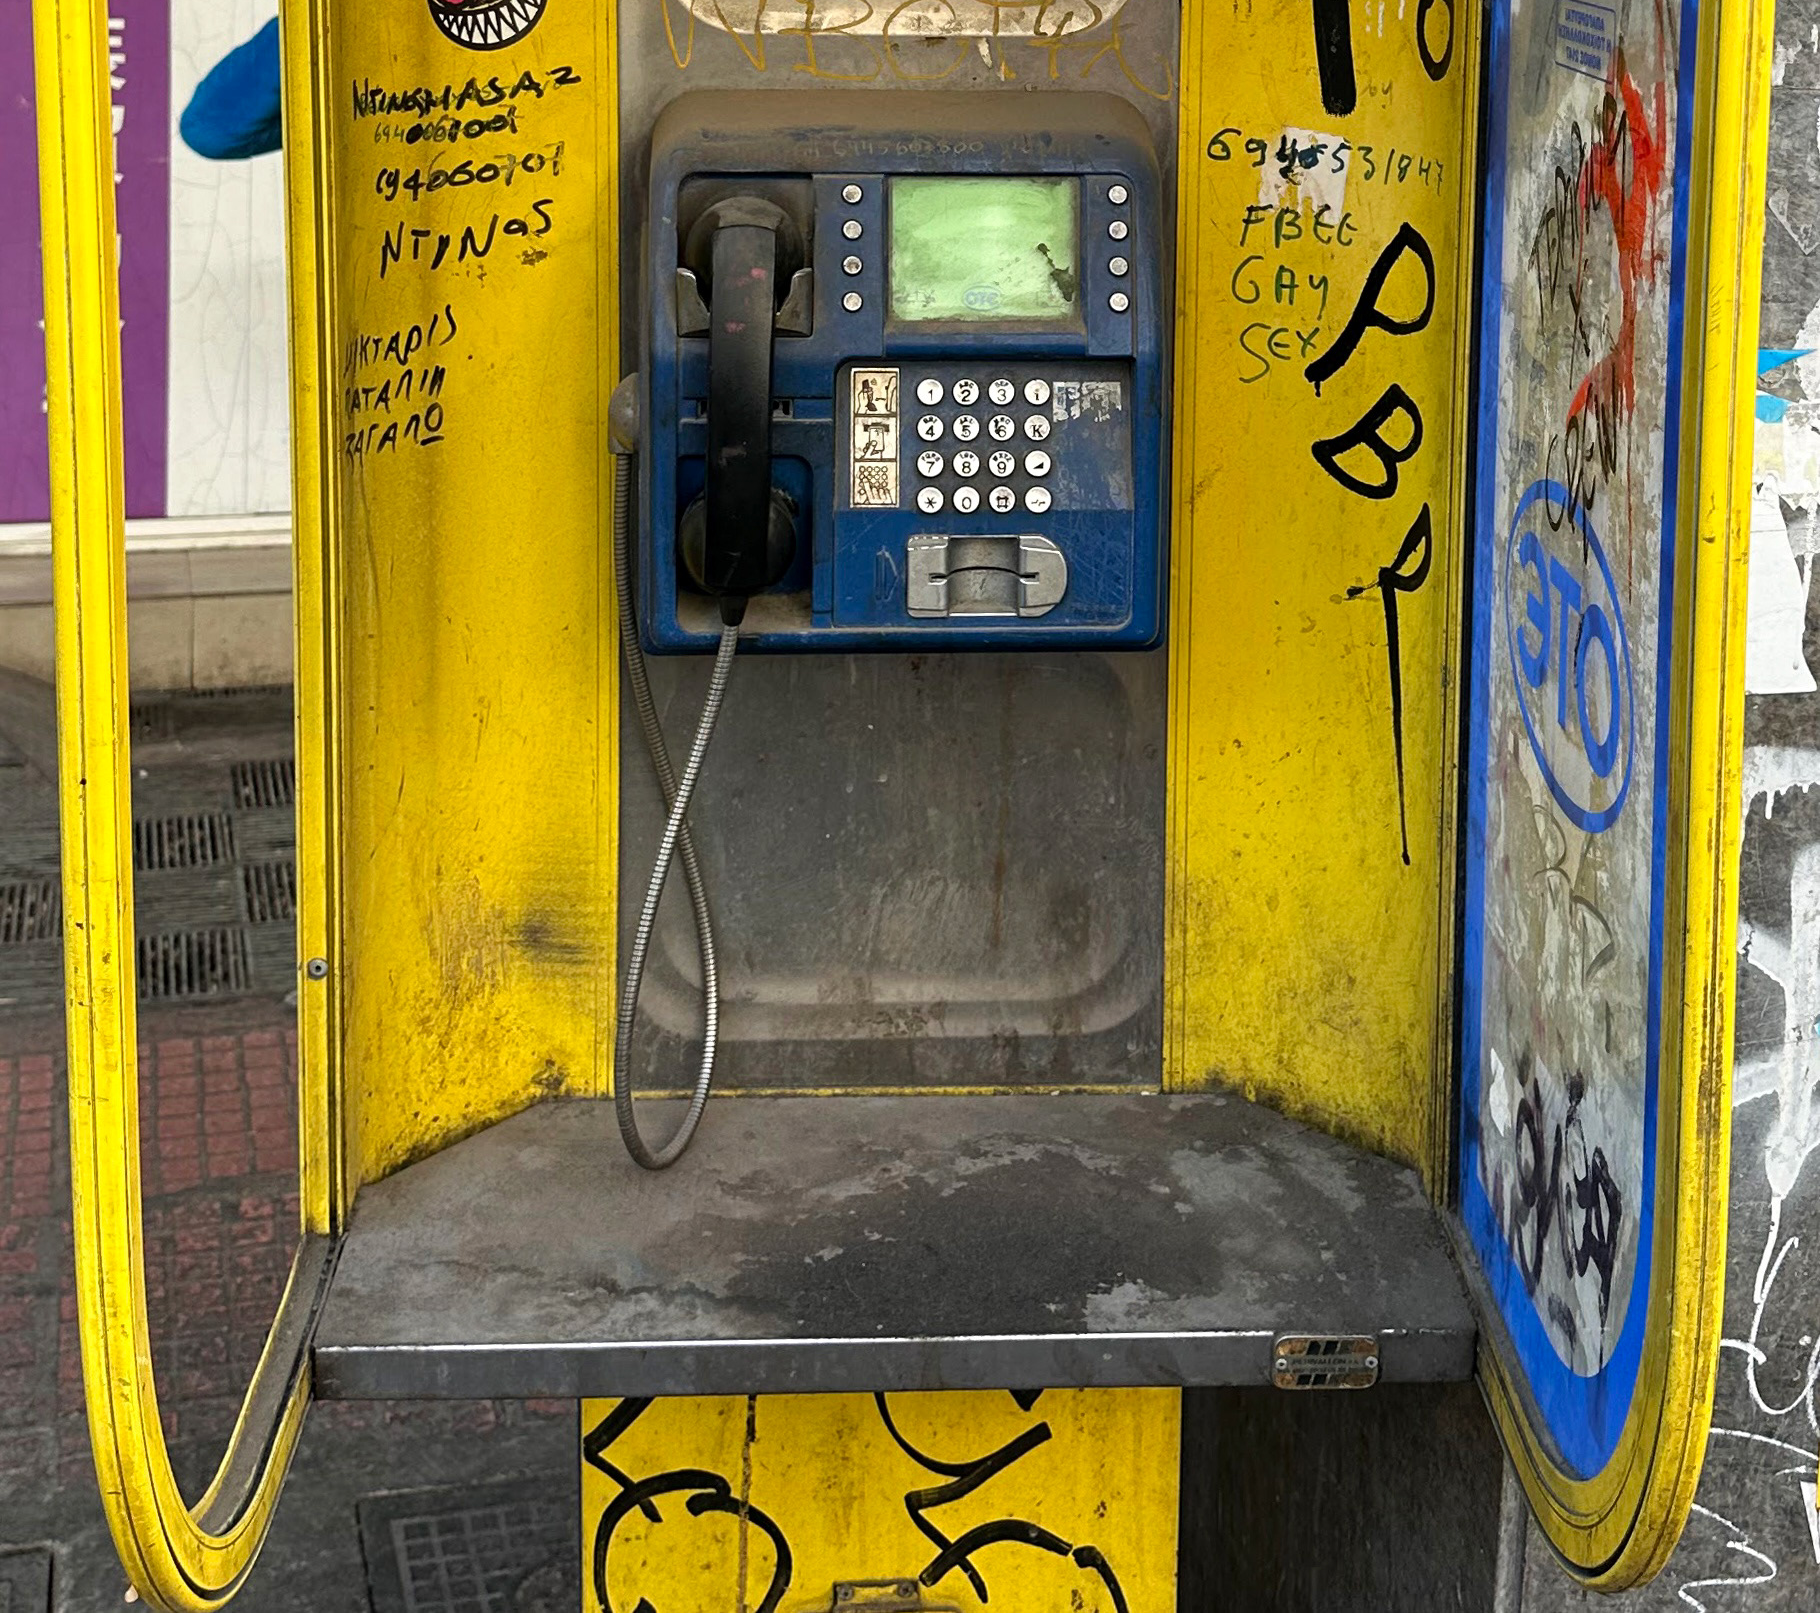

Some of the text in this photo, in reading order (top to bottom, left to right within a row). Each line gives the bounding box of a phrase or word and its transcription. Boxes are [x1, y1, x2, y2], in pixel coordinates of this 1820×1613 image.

[1231, 255, 1329, 322] GAY
[1237, 322, 1320, 384] SEX
[927, 389, 934, 402] 1
[960, 389, 972, 403] 2
[996, 389, 1007, 402] 3
[925, 424, 1044, 438] 4 5 6 K
[926, 461, 1007, 474] 7 8 9
[961, 496, 972, 510] 0
